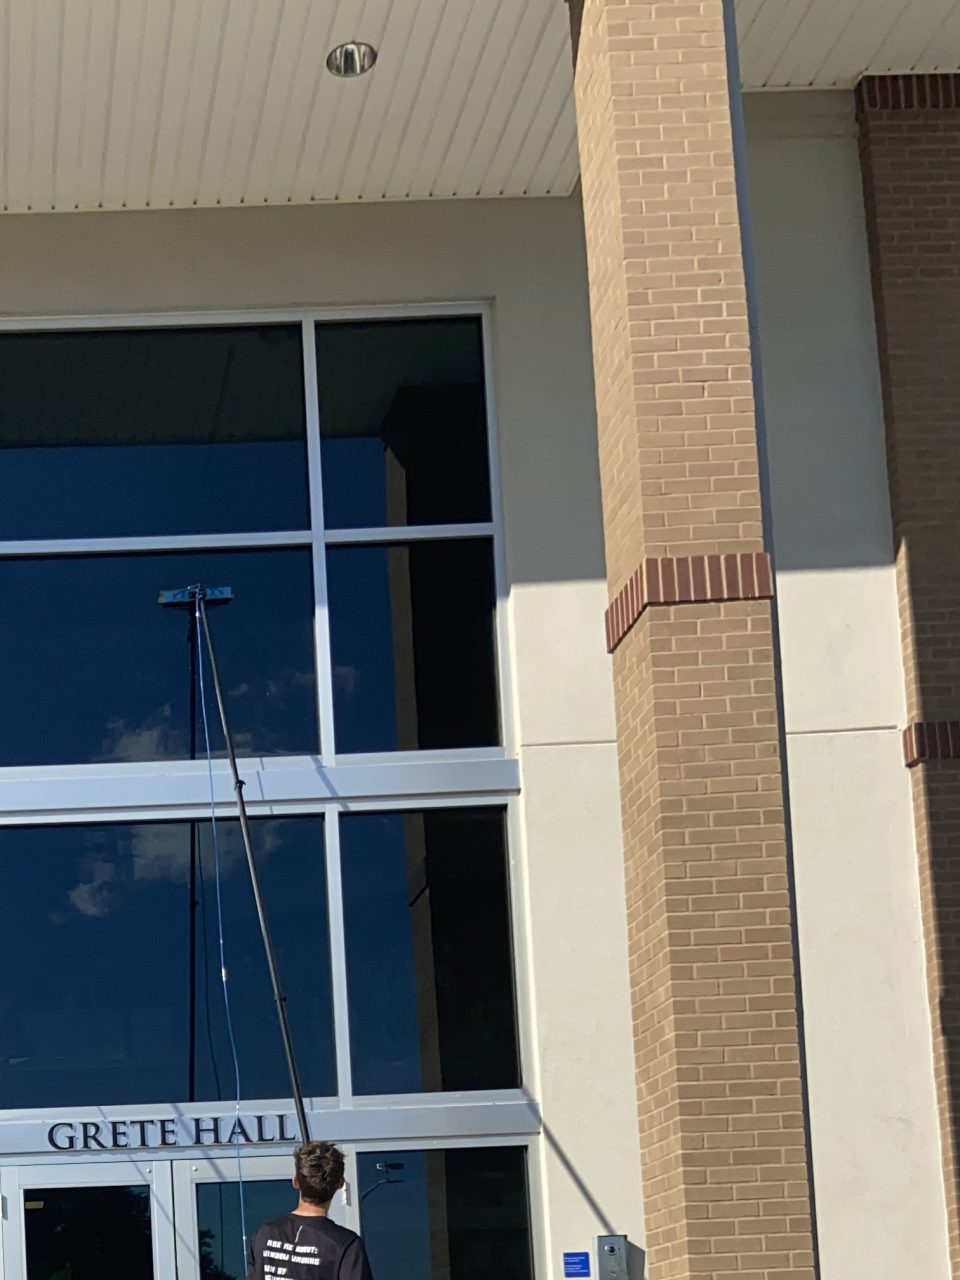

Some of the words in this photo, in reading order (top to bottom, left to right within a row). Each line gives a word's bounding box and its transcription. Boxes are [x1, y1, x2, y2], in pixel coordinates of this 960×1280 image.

[47, 1118, 177, 1150] GRETE
[192, 1113, 296, 1145] HALL
[267, 1240, 281, 1248] ASK
[283, 1243, 294, 1251] ME
